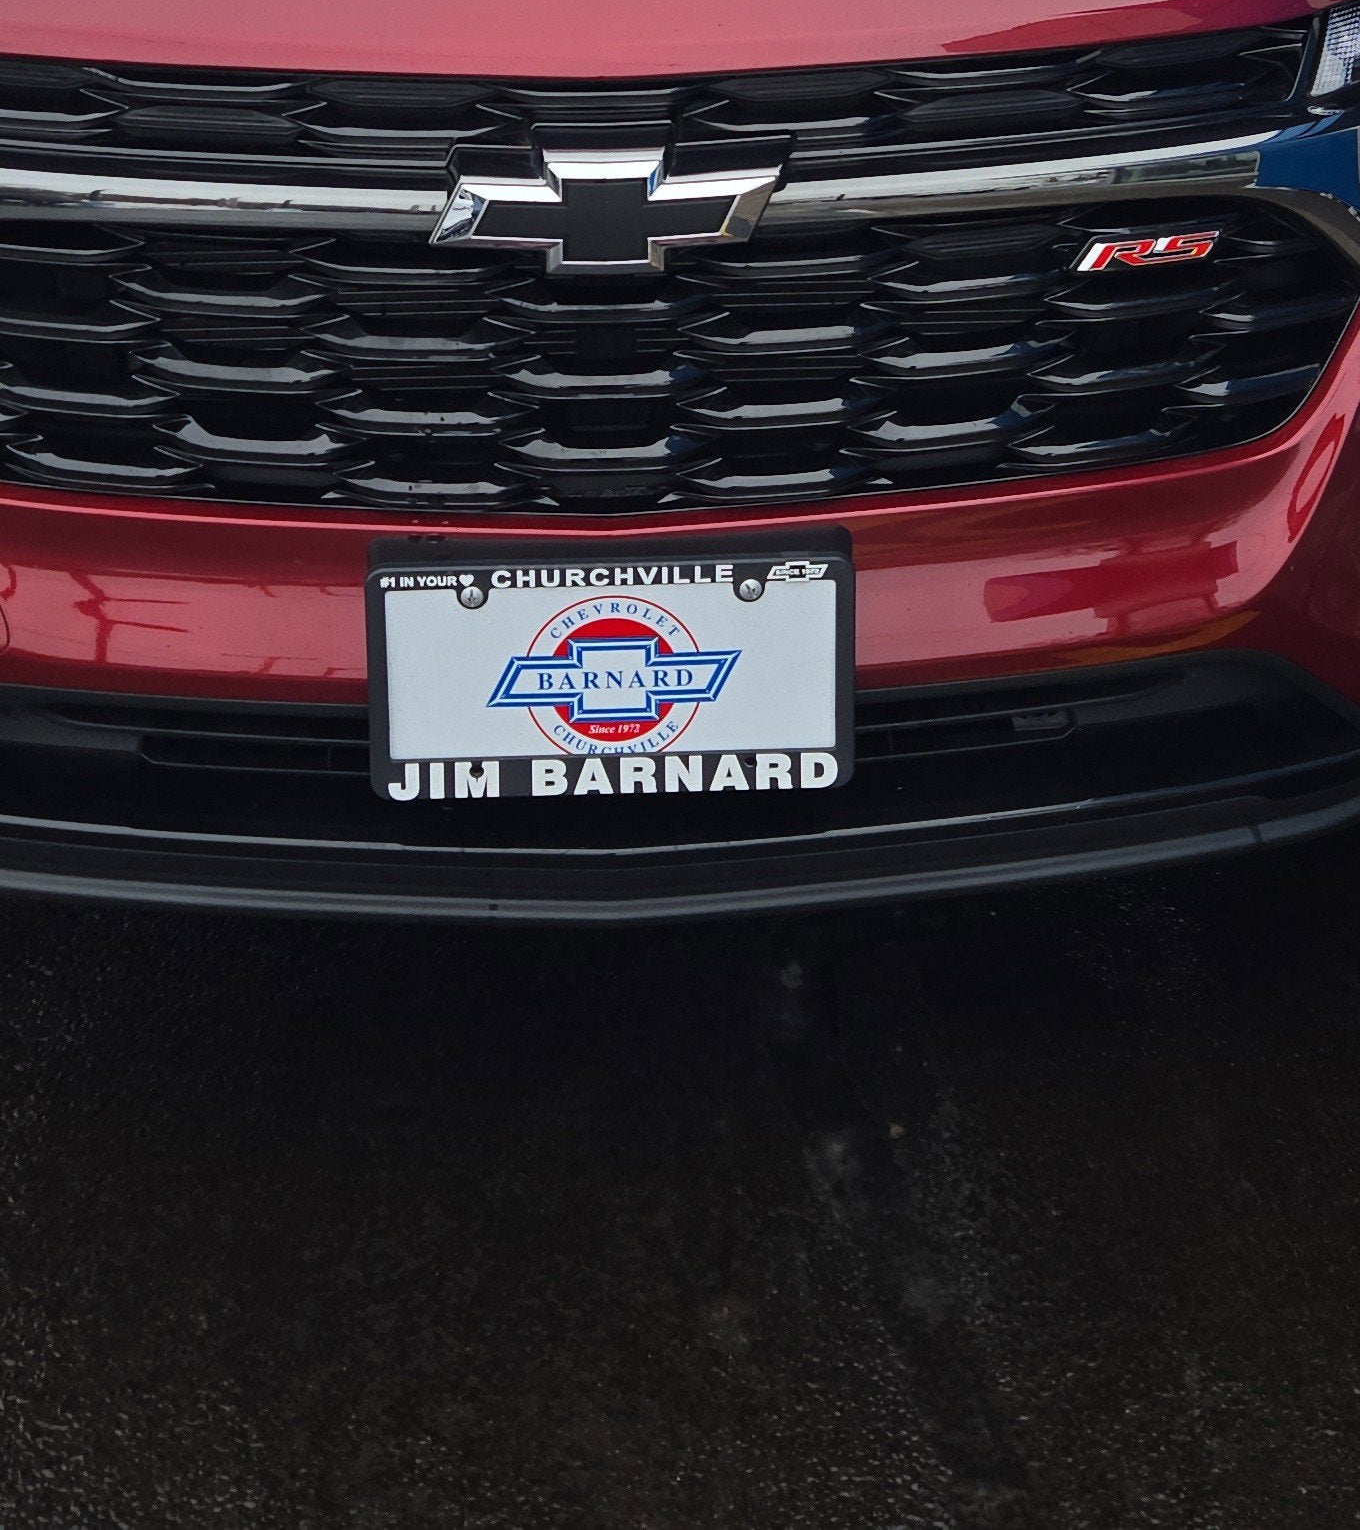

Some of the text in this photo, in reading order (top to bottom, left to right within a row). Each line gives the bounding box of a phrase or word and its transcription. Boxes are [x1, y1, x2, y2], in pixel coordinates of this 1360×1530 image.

[1077, 231, 1220, 272] RS
[379, 574, 458, 589] #1 IN YOUR
[490, 564, 735, 589] CHURCHVILLE
[550, 602, 681, 639] CHEVROLET
[537, 668, 694, 691] BARNARD
[553, 720, 679, 755] CHURCHVILLE
[588, 724, 616, 735] Since
[388, 752, 839, 802] JIM BARNARD
